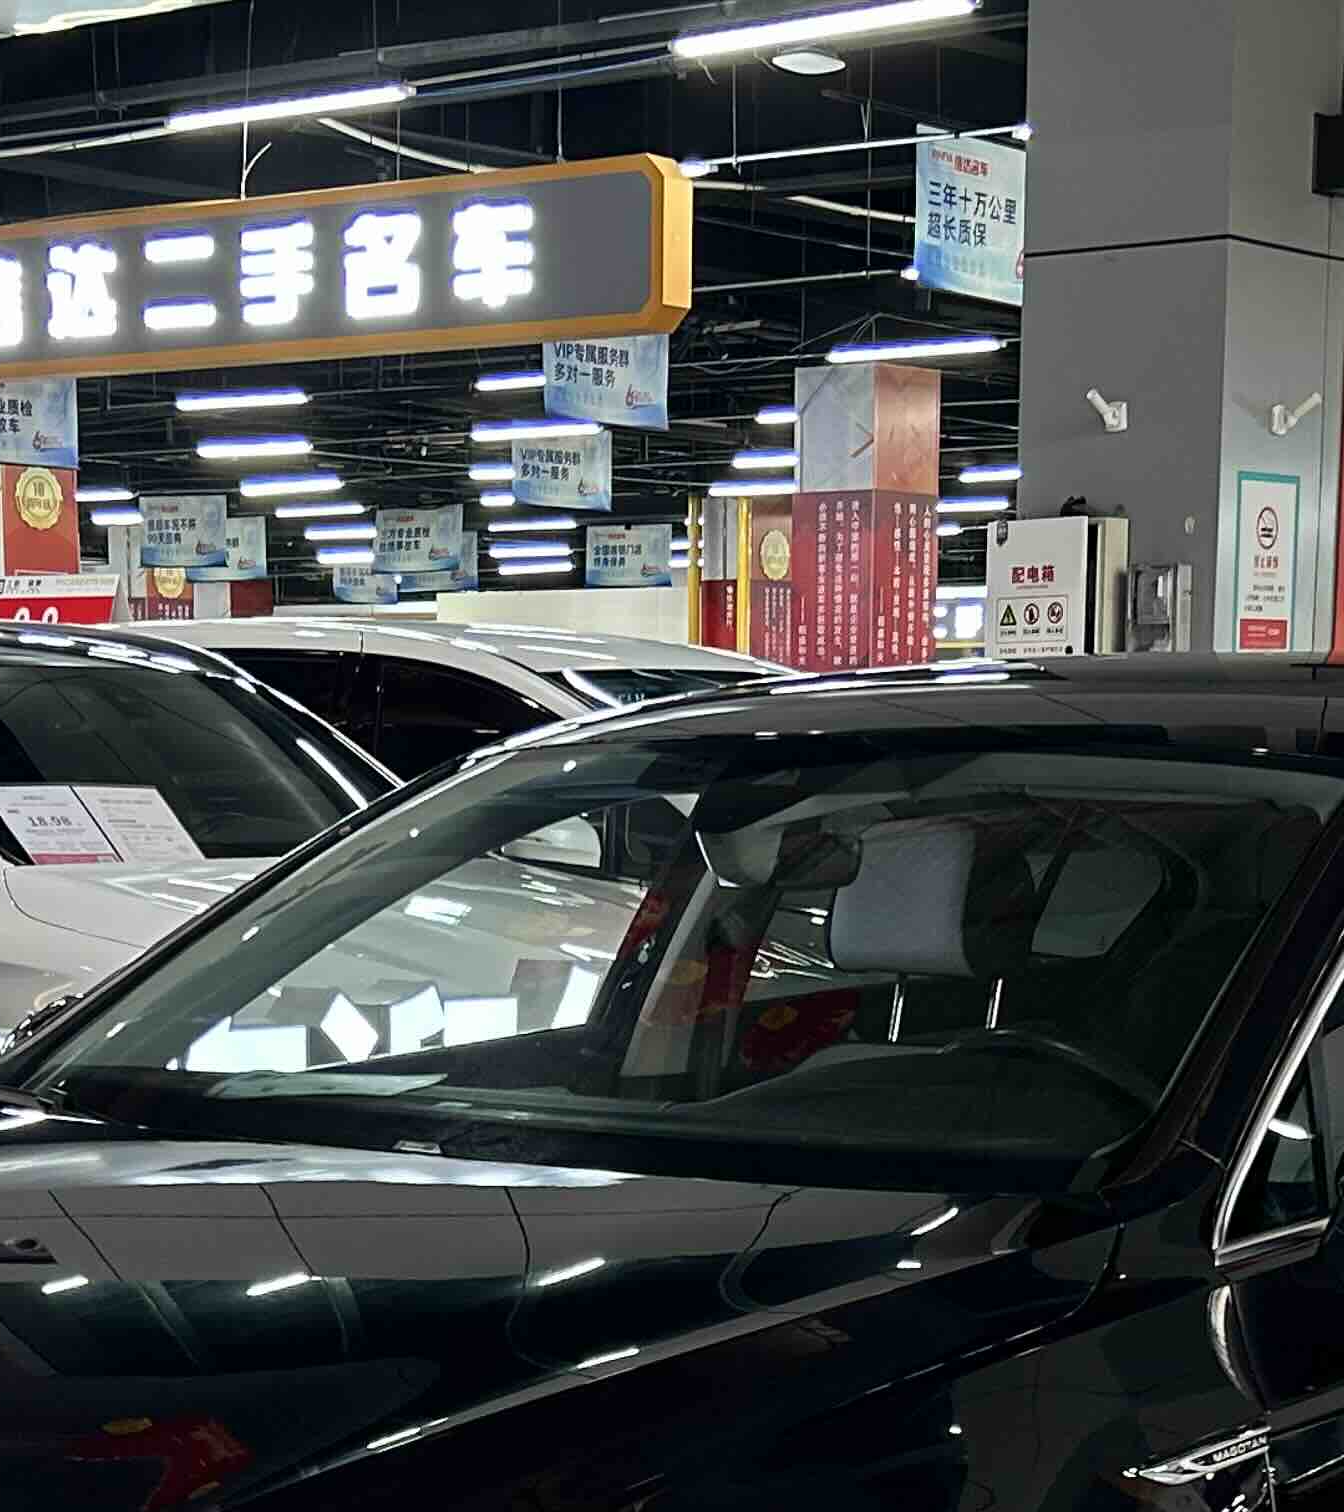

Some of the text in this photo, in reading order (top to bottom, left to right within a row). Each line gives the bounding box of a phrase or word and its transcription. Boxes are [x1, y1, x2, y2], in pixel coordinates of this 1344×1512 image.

[928, 180, 1017, 225] 三年十万公里
[927, 211, 987, 247] 超长质保
[553, 343, 630, 368] VIP专属服务群
[554, 362, 617, 388] 多对一服务
[1011, 564, 1055, 585] 配电箱
